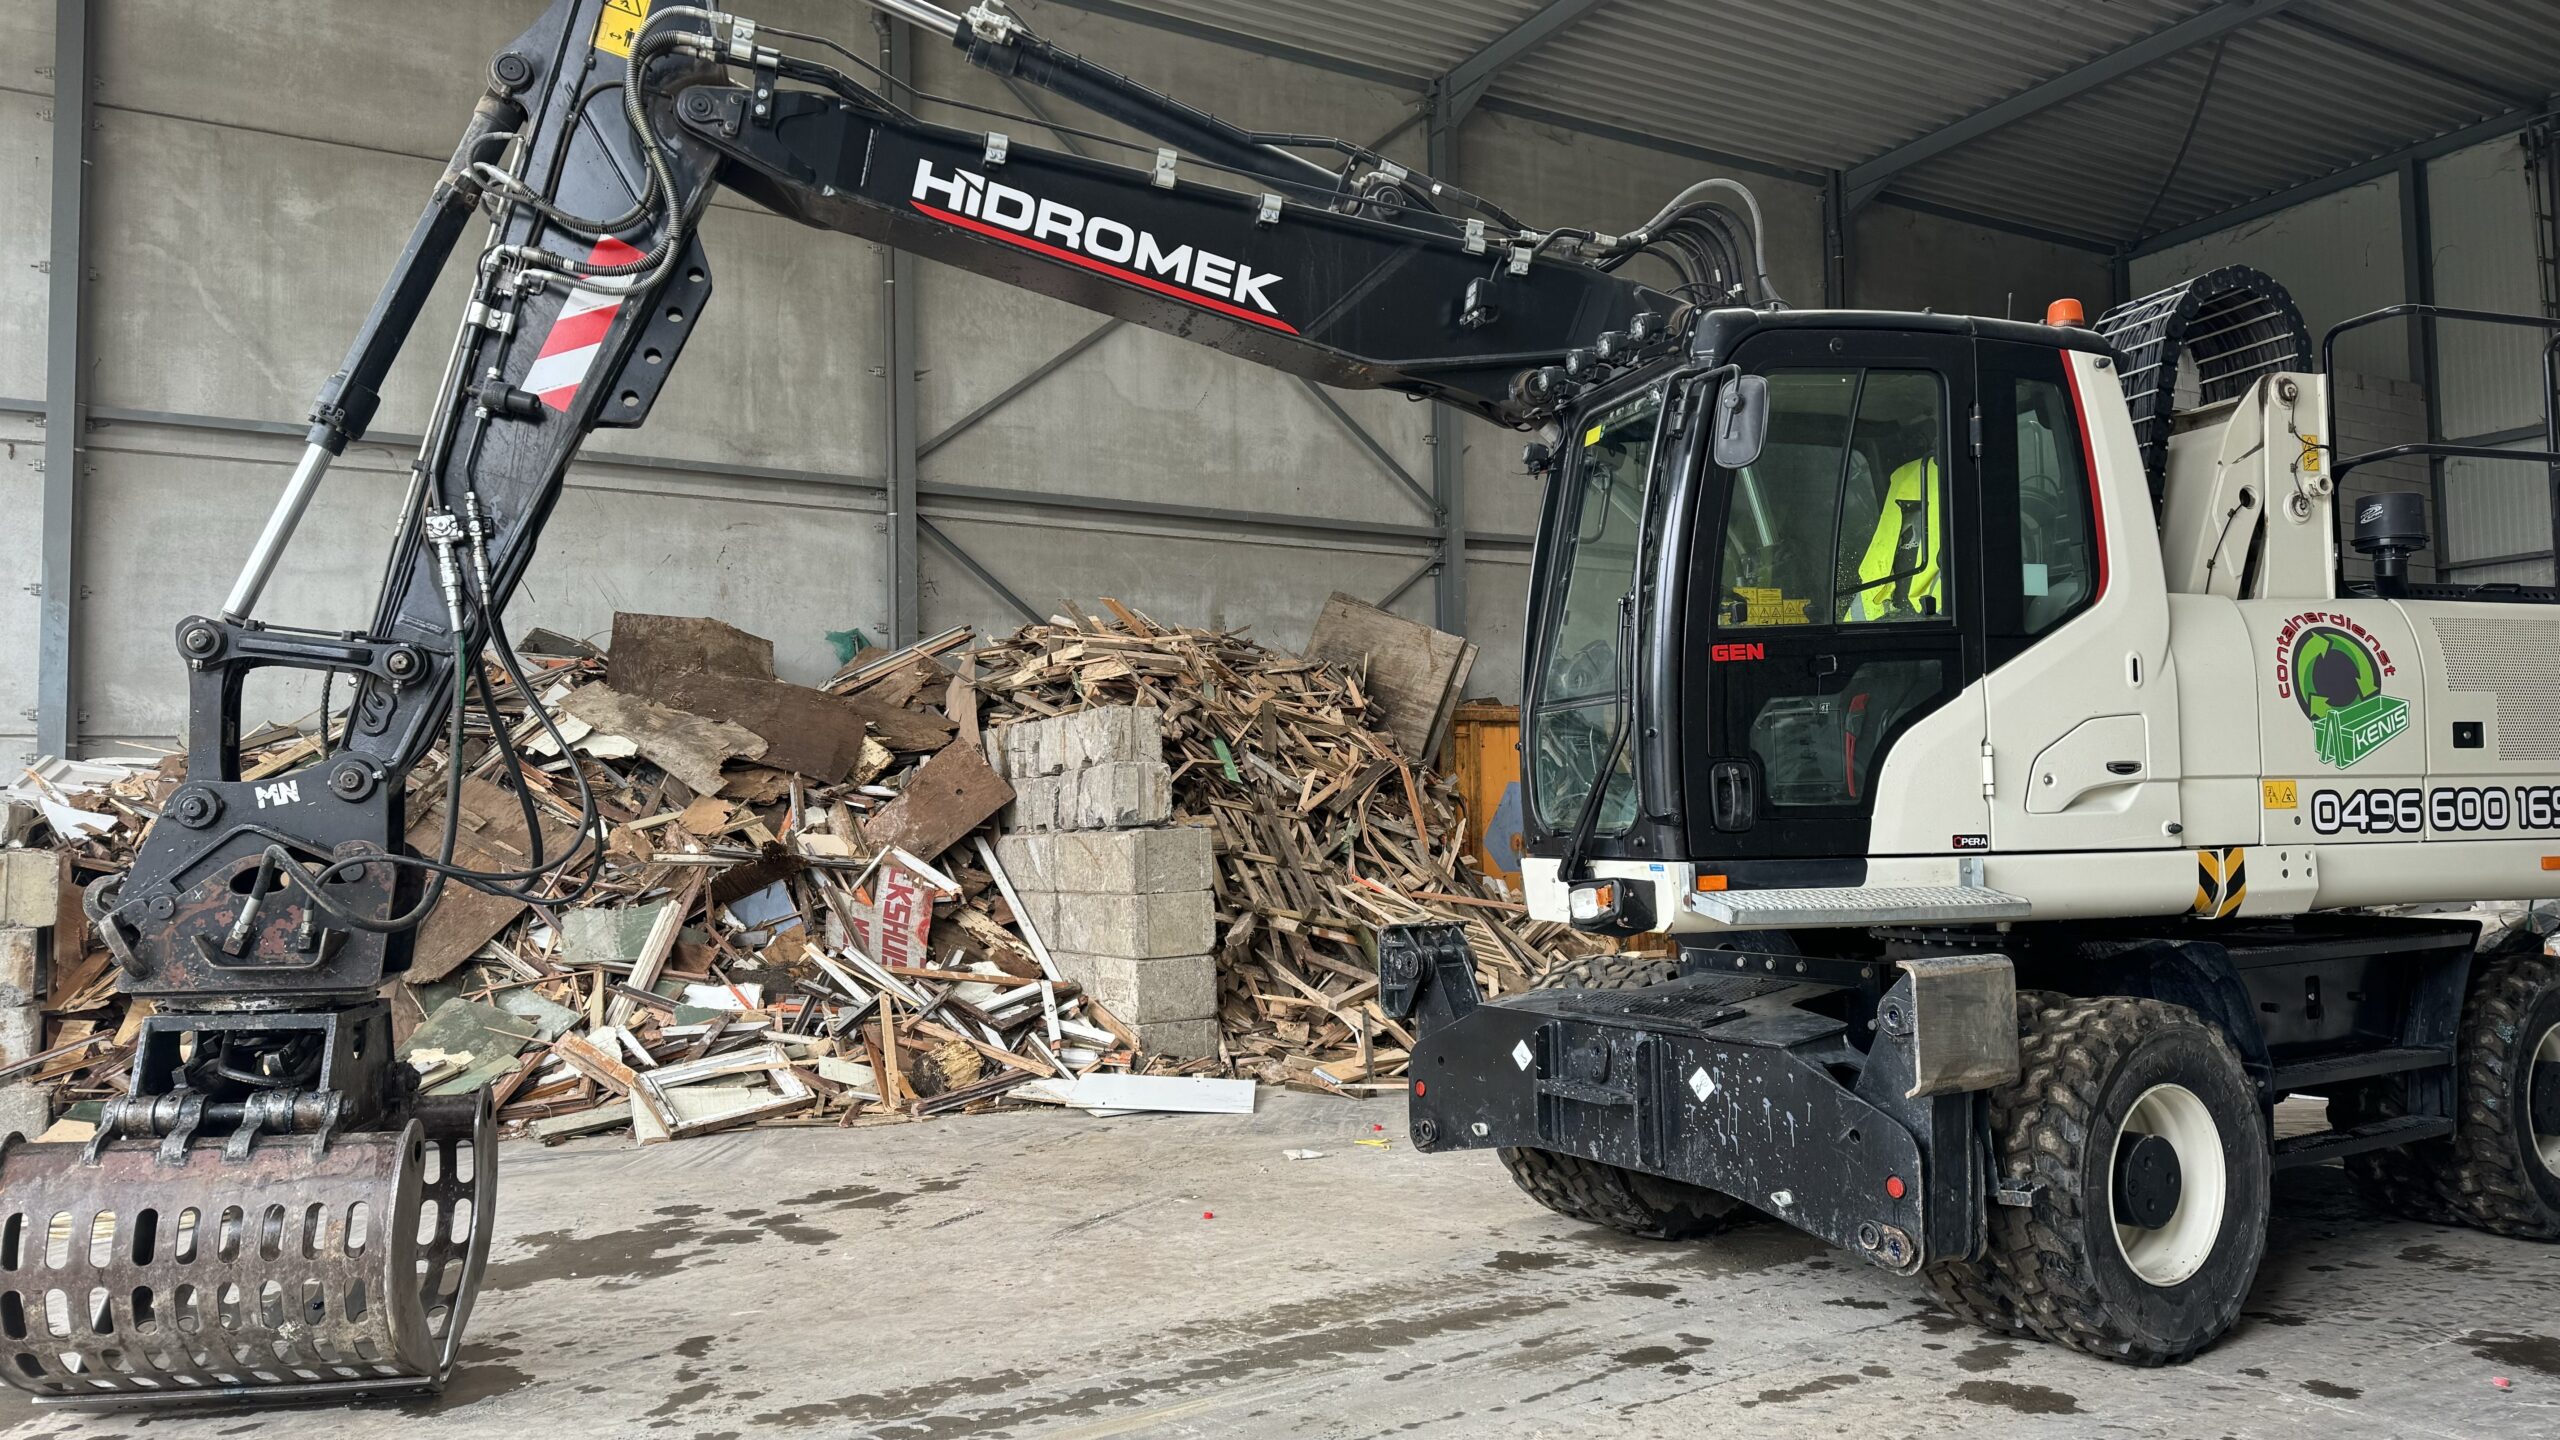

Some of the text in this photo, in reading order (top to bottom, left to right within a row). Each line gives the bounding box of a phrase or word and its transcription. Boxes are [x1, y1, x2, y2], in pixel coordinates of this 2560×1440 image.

[1711, 642, 1765, 662] GEN
[2276, 611, 2396, 699] containerdienst
[2355, 708, 2407, 751] KENIS
[2312, 789, 2423, 835] 0496
[2430, 786, 2510, 832] 600
[1953, 836, 1987, 848] OPERA
